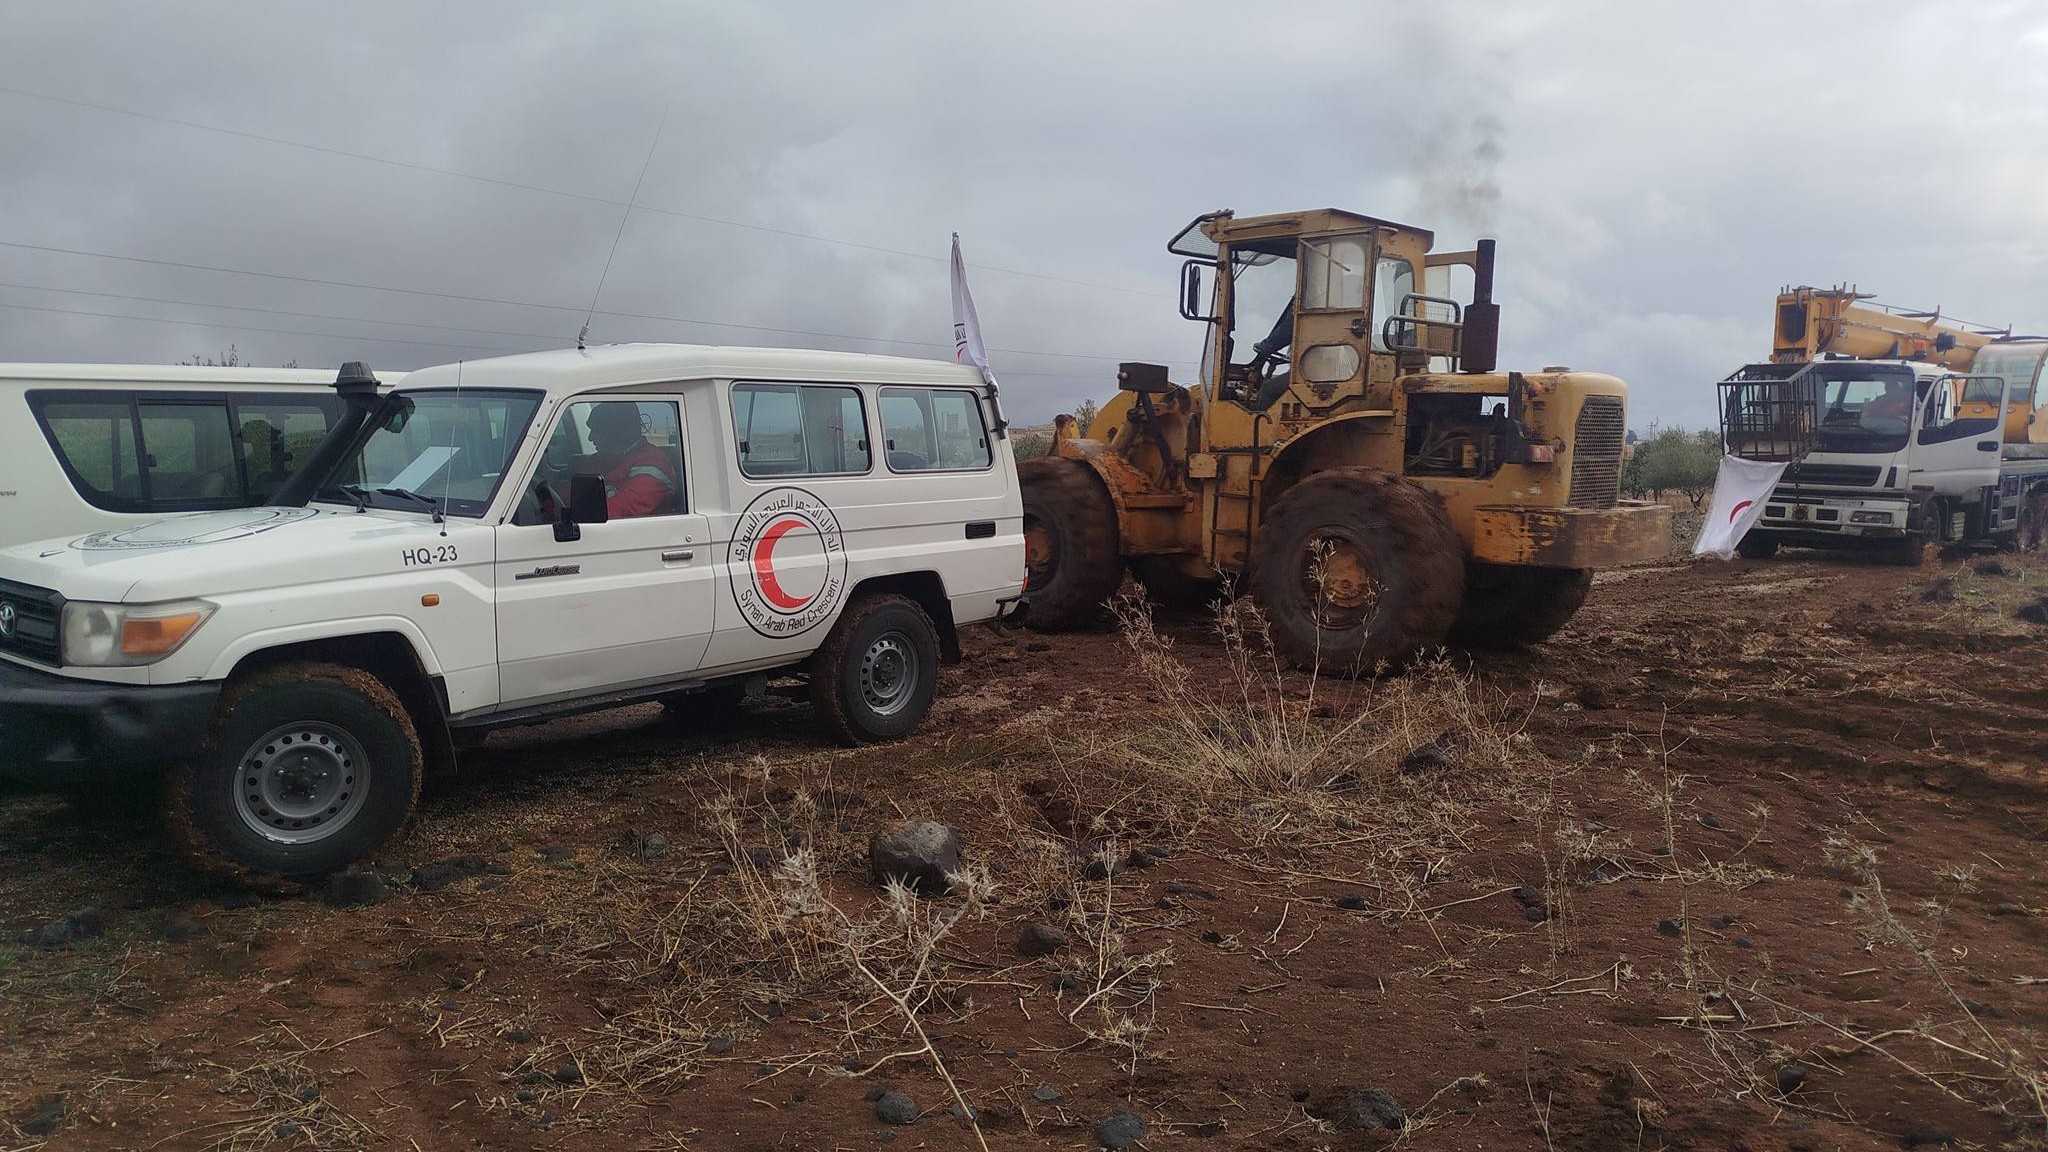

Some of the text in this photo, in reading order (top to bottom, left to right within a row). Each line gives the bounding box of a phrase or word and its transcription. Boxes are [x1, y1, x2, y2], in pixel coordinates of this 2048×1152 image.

[759, 493, 793, 519] العربي
[735, 511, 760, 561] السوري
[820, 517, 840, 553] الهلال
[402, 545, 458, 566] HQ-23
[741, 577, 840, 632] Syrian Arab Red Crescent
